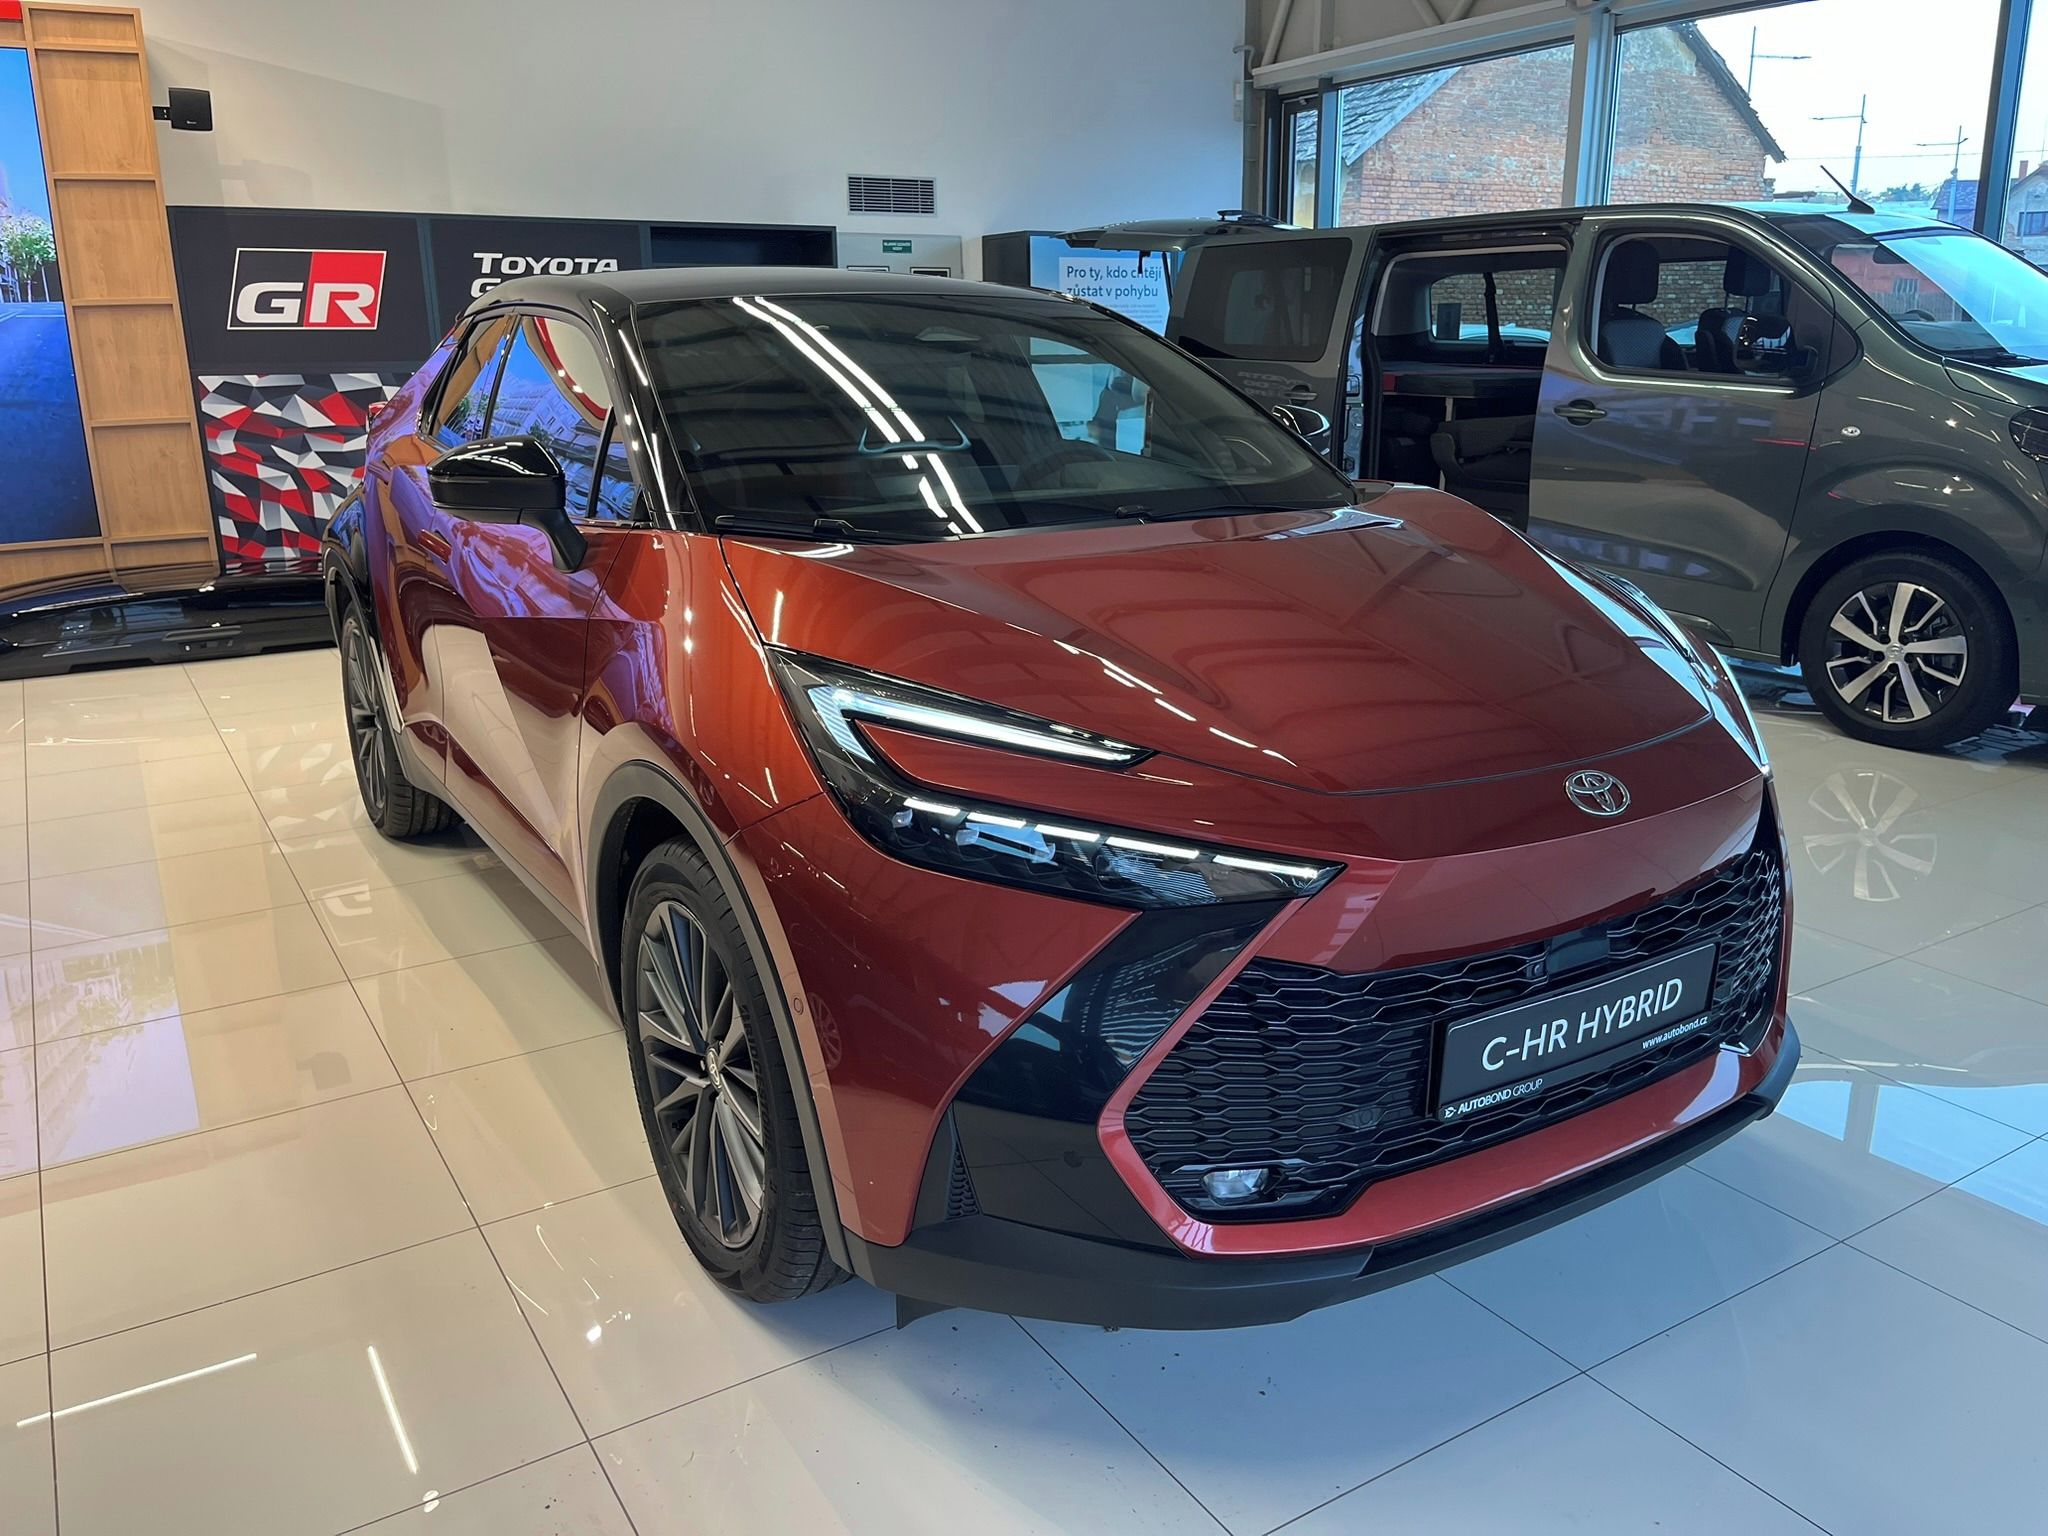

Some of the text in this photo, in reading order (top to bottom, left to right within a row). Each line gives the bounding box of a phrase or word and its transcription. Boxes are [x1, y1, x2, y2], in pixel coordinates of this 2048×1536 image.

[472, 252, 619, 275] TOYOTA
[1066, 265, 1087, 279] Pro
[1089, 266, 1103, 281] ty,
[1106, 265, 1128, 279] kdo
[236, 281, 376, 324] GR
[1105, 287, 1113, 297] v
[1115, 284, 1158, 300] pohybu
[1481, 977, 1683, 1072] C-HR HYBRID
[1642, 1016, 1708, 1049] www.autobond.cz
[1457, 1078, 1543, 1115] AUTOBOND GROUP
